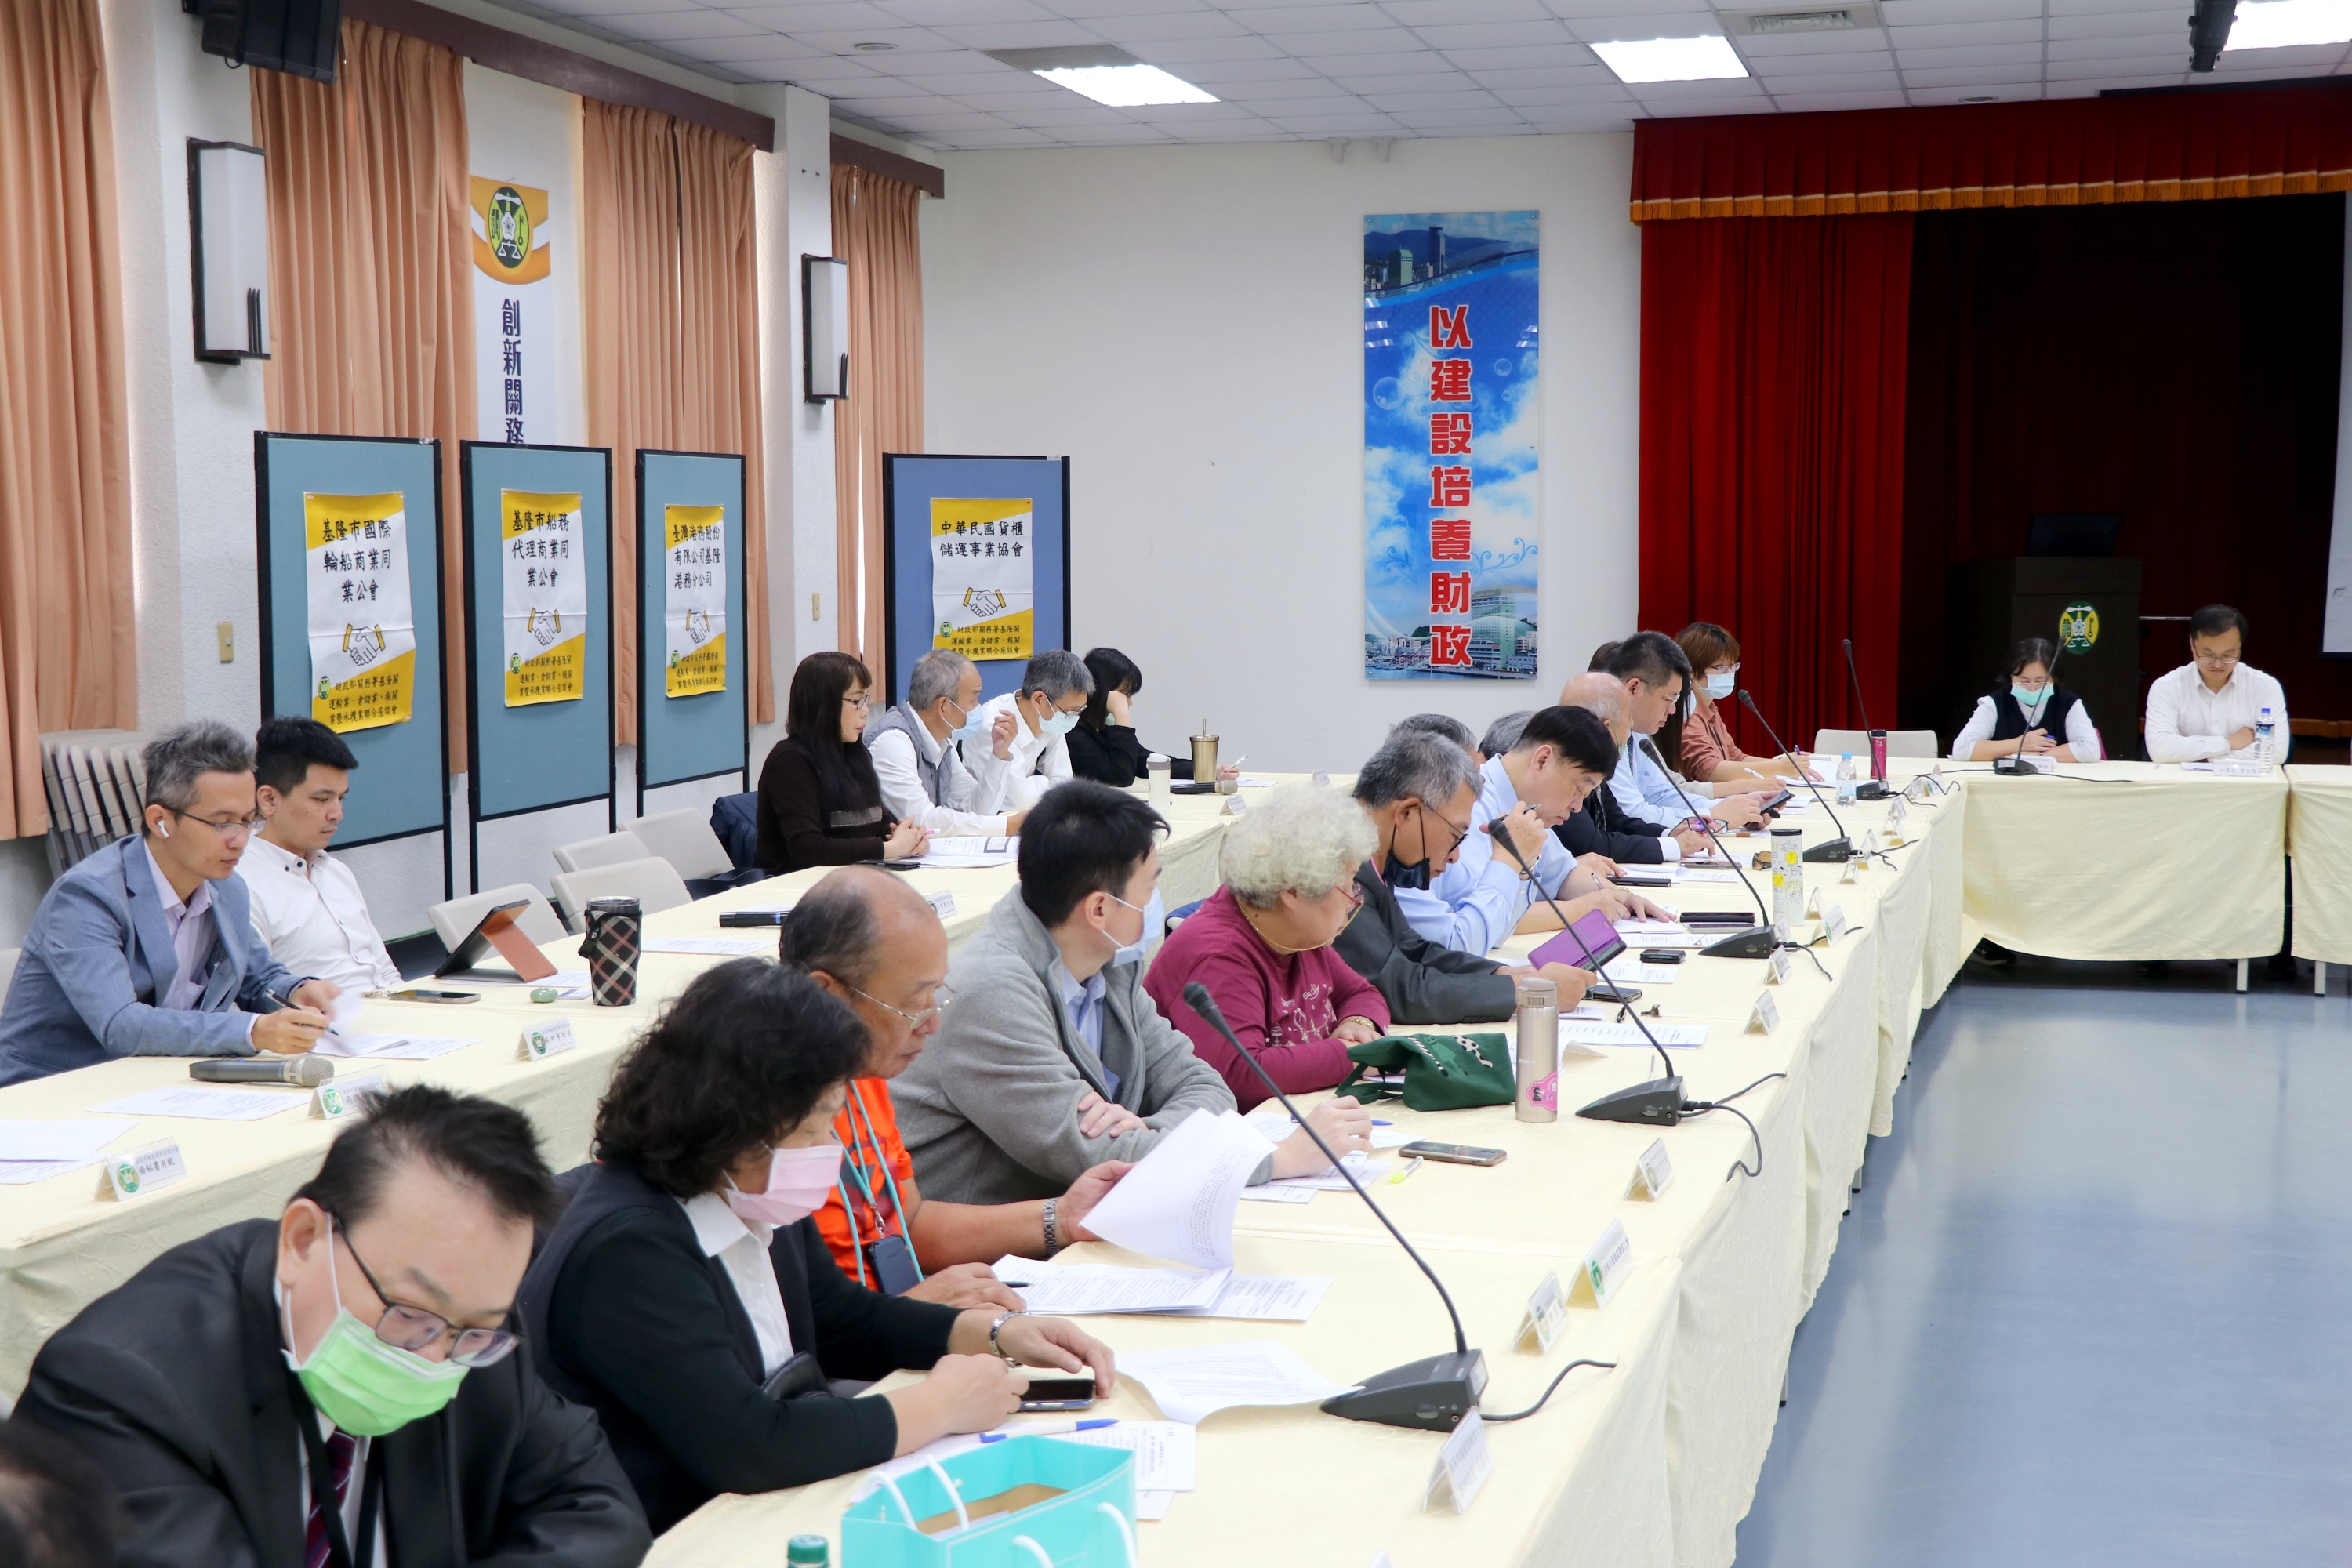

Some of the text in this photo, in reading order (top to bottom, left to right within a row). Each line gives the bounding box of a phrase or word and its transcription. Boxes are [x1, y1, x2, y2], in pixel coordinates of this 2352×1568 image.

[502, 298, 524, 443] 創新關務
[1430, 305, 1472, 667] 以建設培養財政
[322, 518, 391, 543] 基隆市國際
[512, 509, 570, 532] 基隆市船務
[941, 520, 1024, 536] 中華民國貨櫃
[323, 548, 391, 573] 輪船商業同
[511, 539, 569, 560] 代理商業同
[674, 547, 721, 566] 有限公司基隆
[939, 541, 1024, 558] 儲運事業協會
[527, 566, 559, 588] 業公會
[674, 570, 713, 590] 港務分公司
[341, 578, 379, 603] 業公會
[957, 625, 1021, 633] 財政部關務署基隆關
